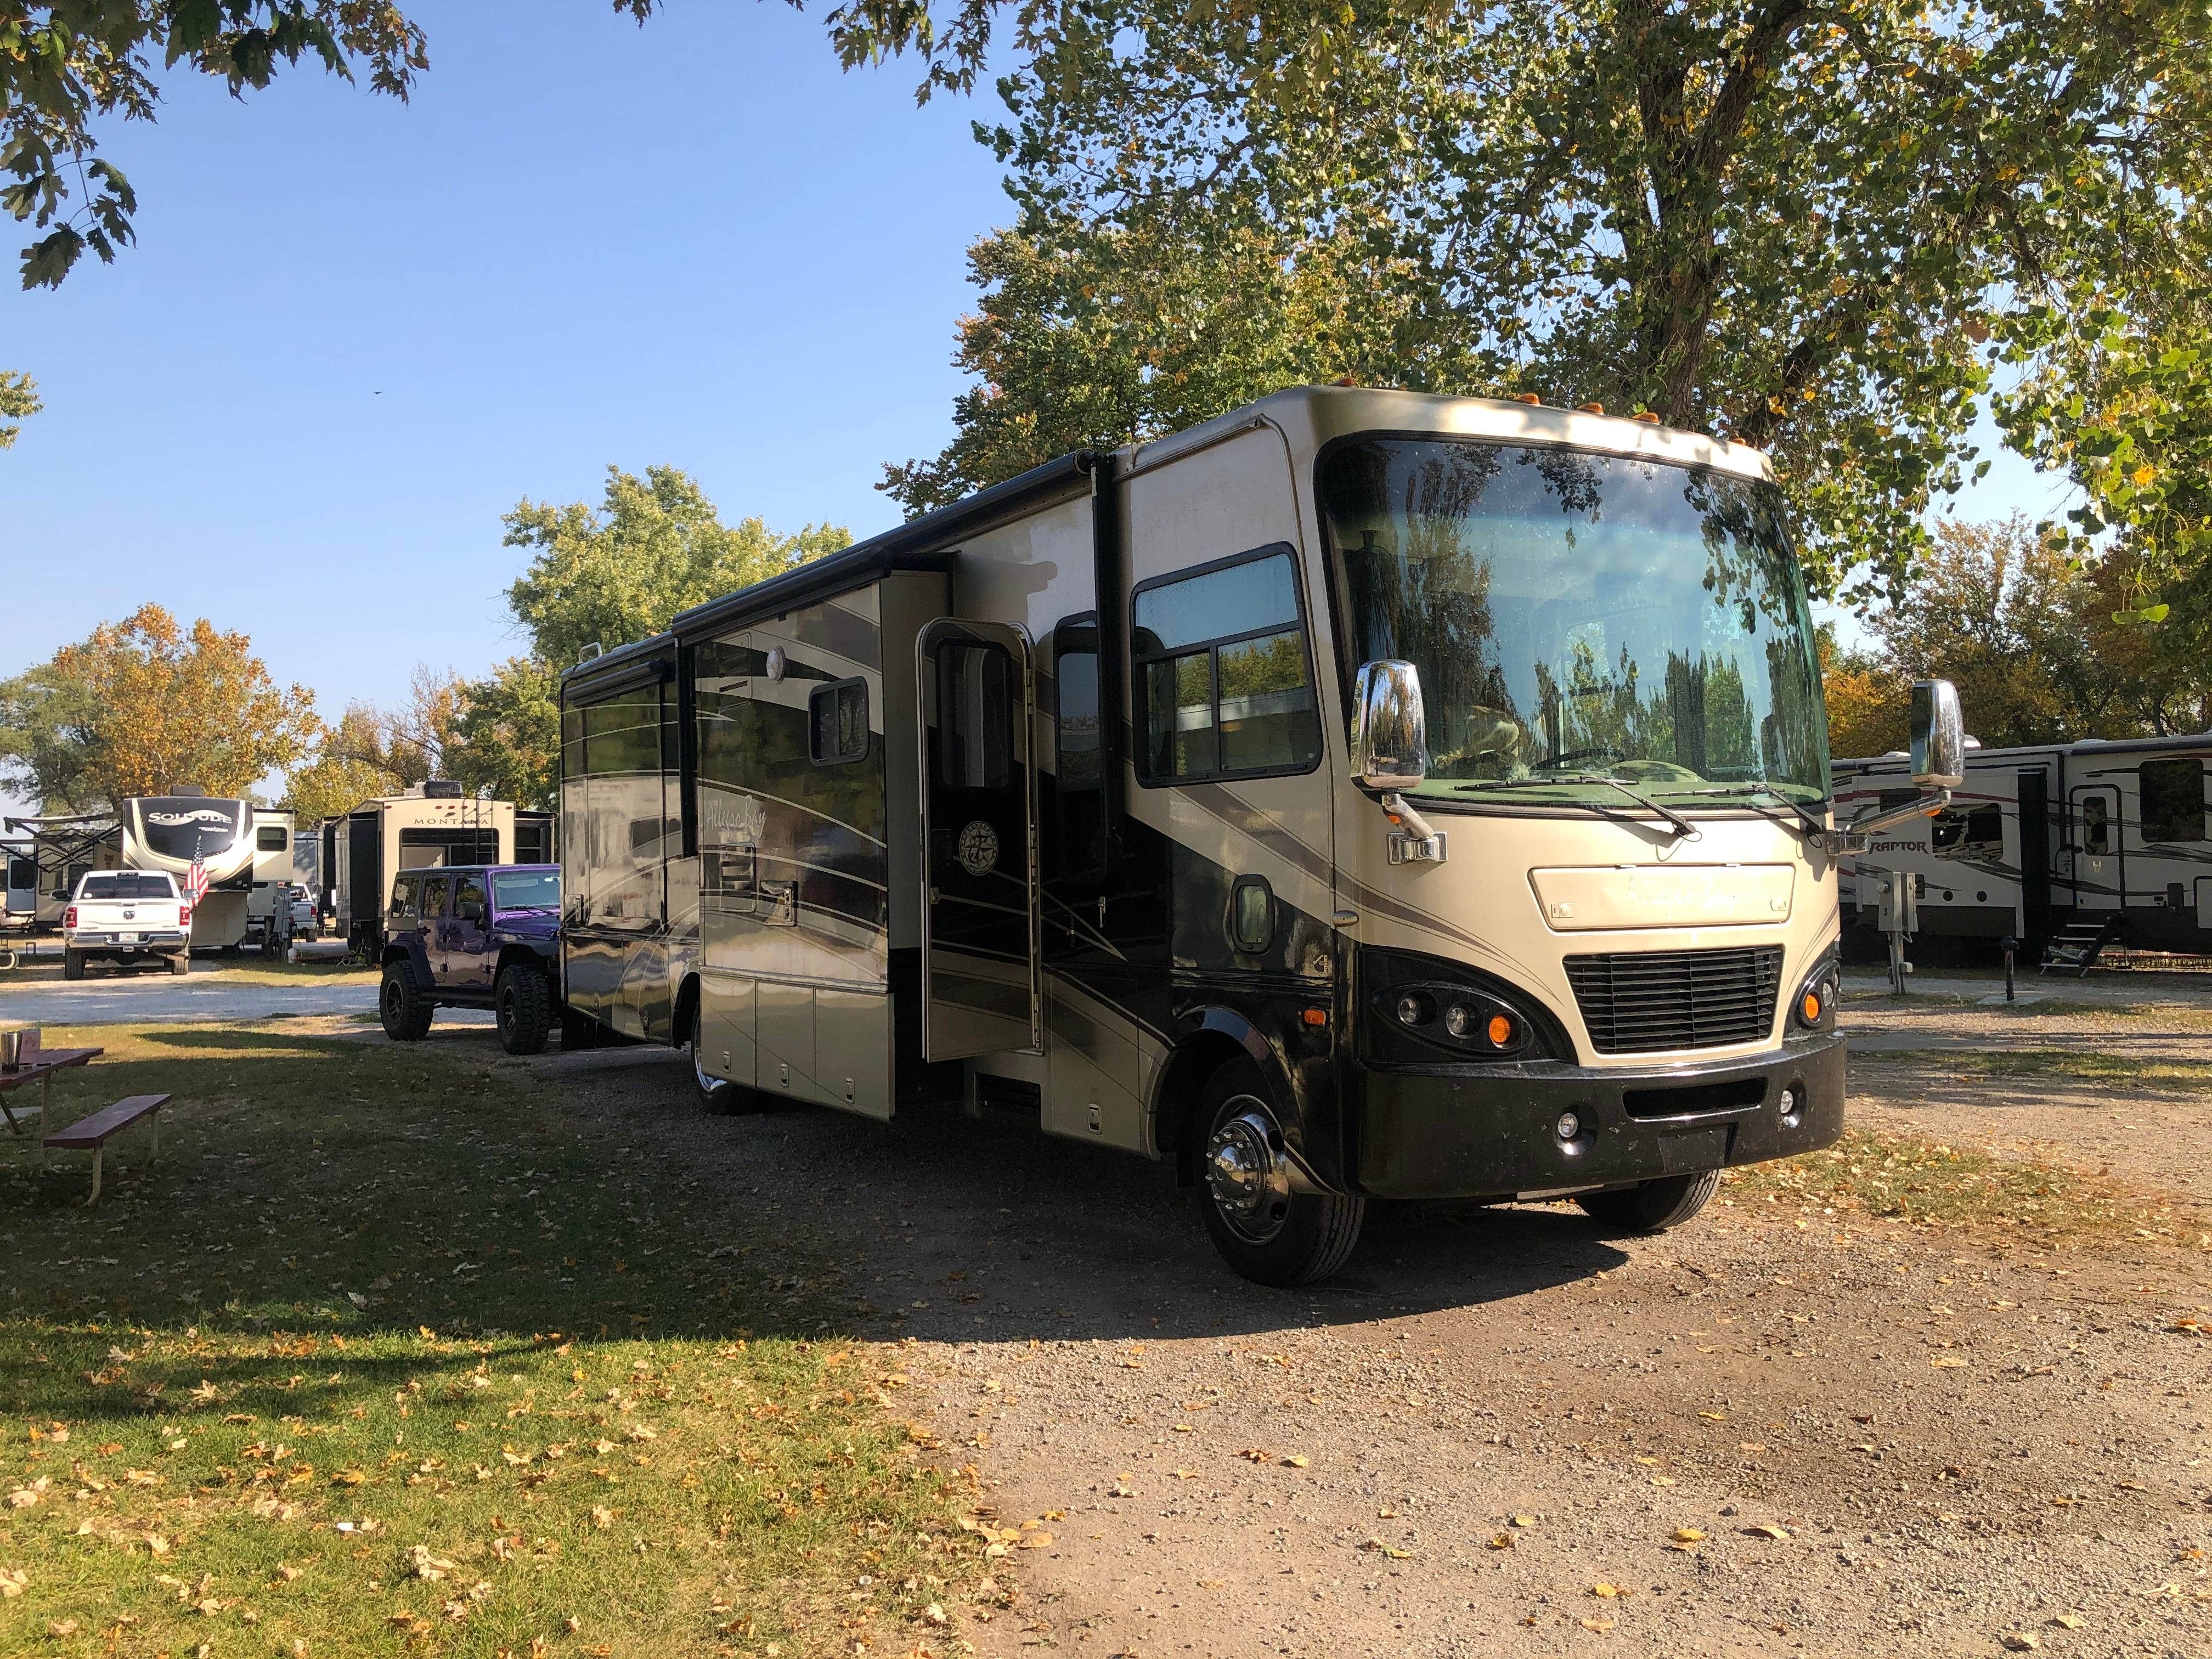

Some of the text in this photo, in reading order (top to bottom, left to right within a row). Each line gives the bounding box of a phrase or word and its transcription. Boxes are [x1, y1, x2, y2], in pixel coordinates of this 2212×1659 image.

[1868, 841, 1929, 855] RAPTOR
[1908, 882, 1912, 890] 4
[1883, 907, 1888, 916] 3
